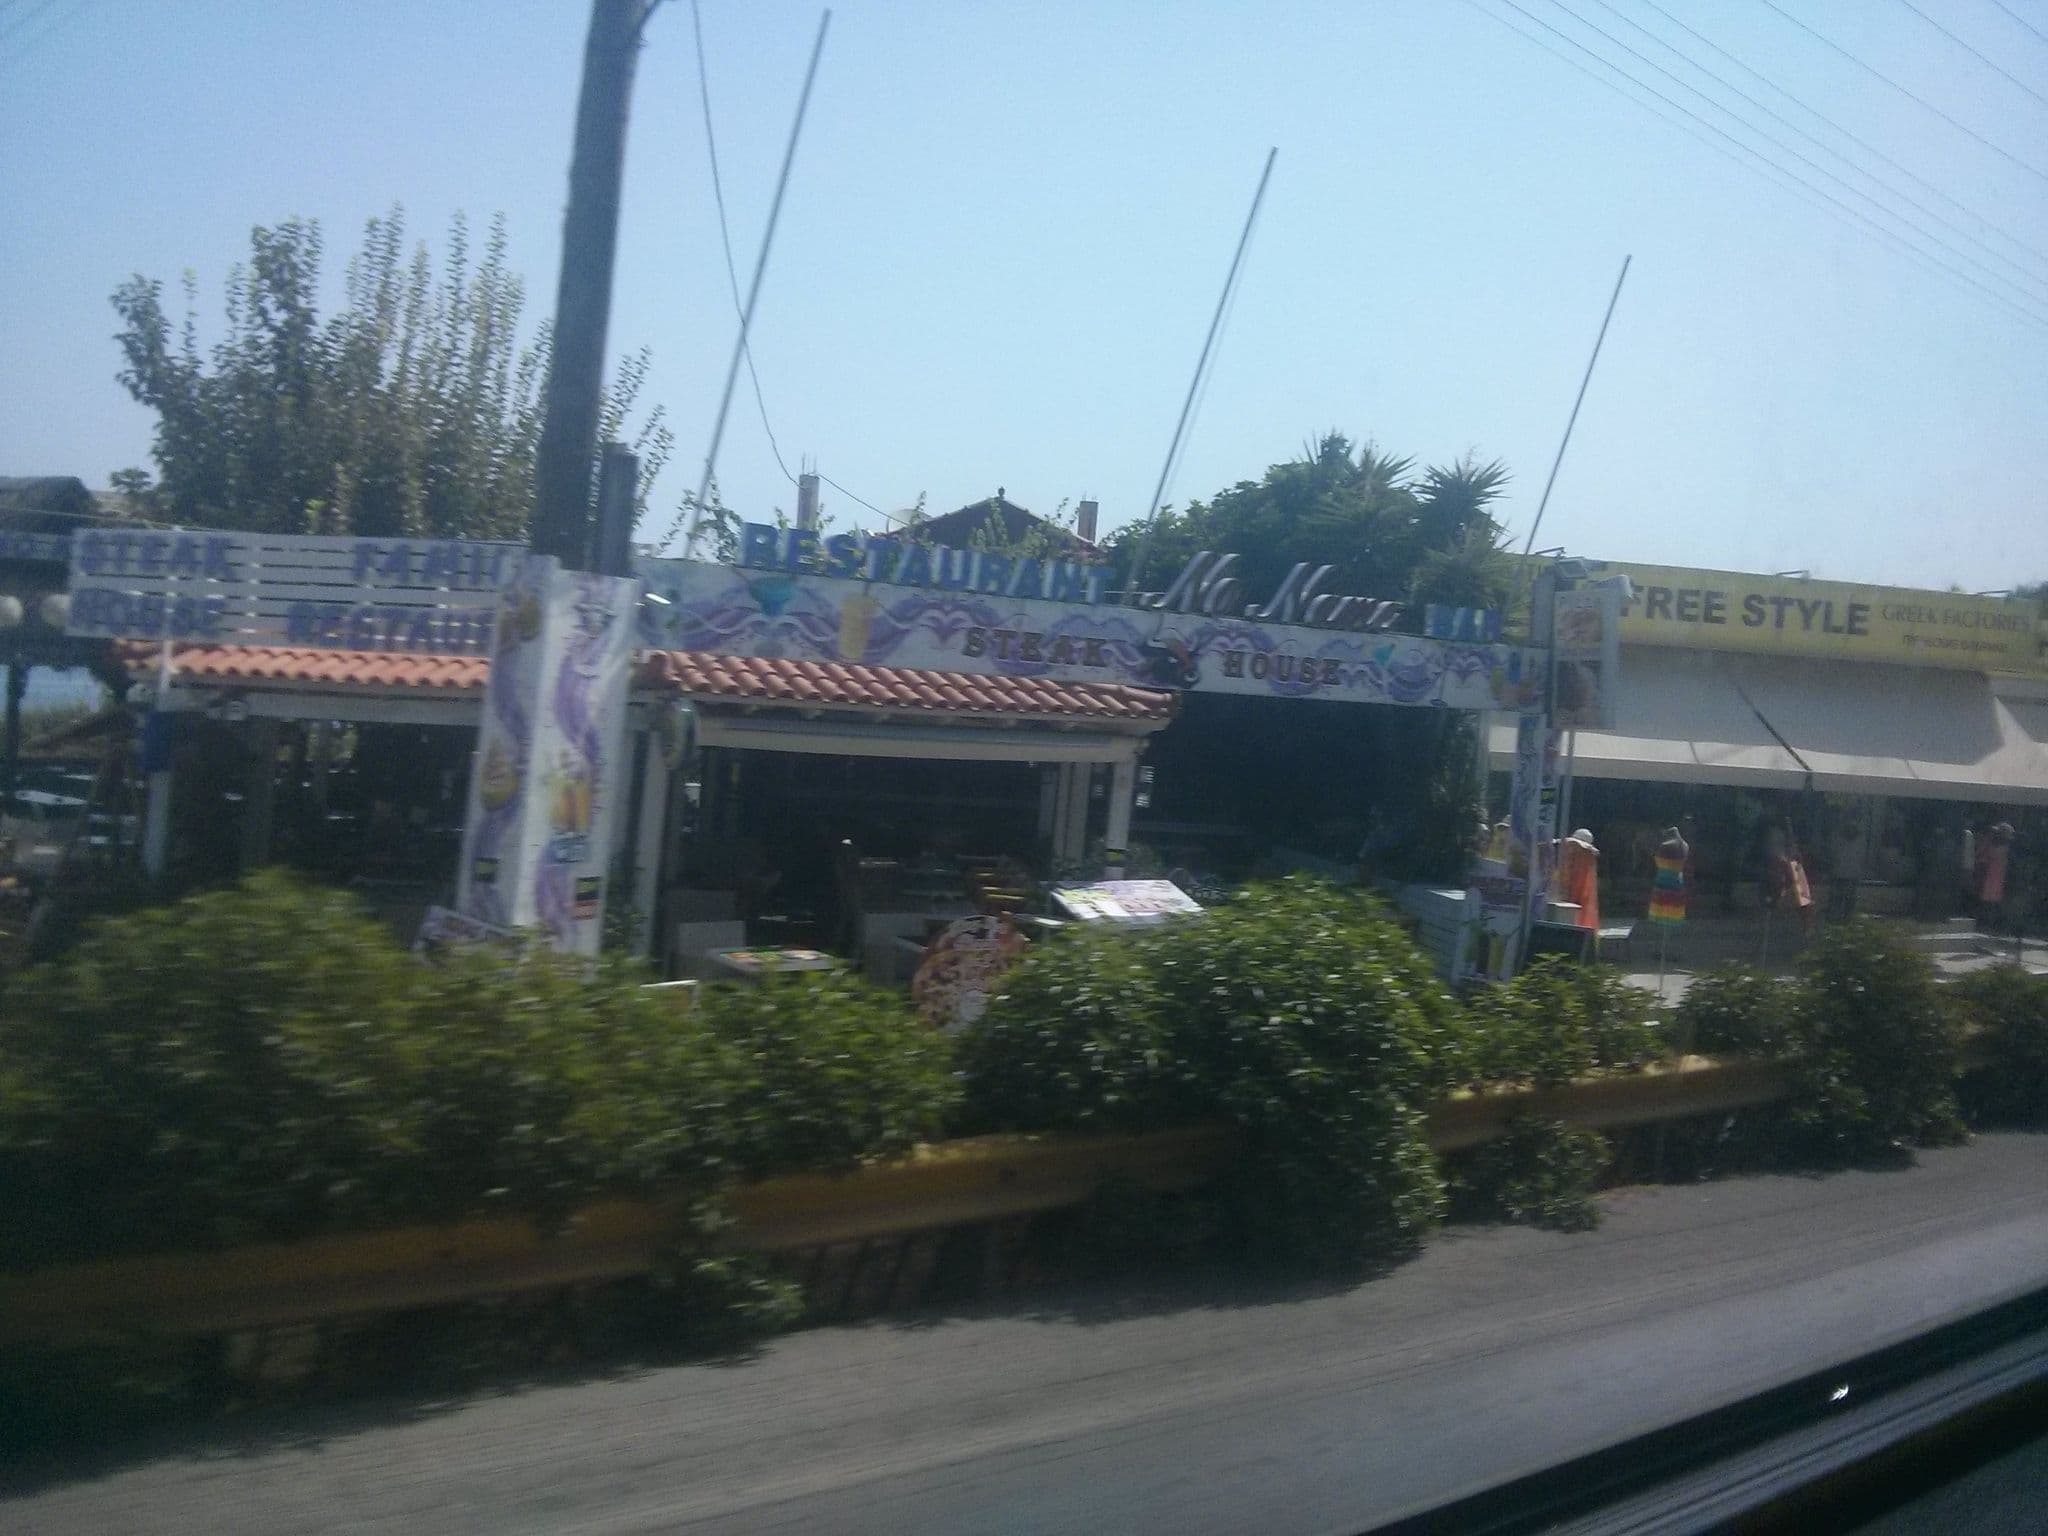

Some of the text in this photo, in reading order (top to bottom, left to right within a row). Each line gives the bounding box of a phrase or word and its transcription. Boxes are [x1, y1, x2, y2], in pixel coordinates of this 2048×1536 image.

[80, 530, 234, 579] STEAK
[741, 522, 1114, 603] RESTAURANT
[74, 587, 223, 636] HOUSE
[1621, 585, 1870, 637] FREE STYLE
[962, 627, 1341, 685] STEAK HOUSE
